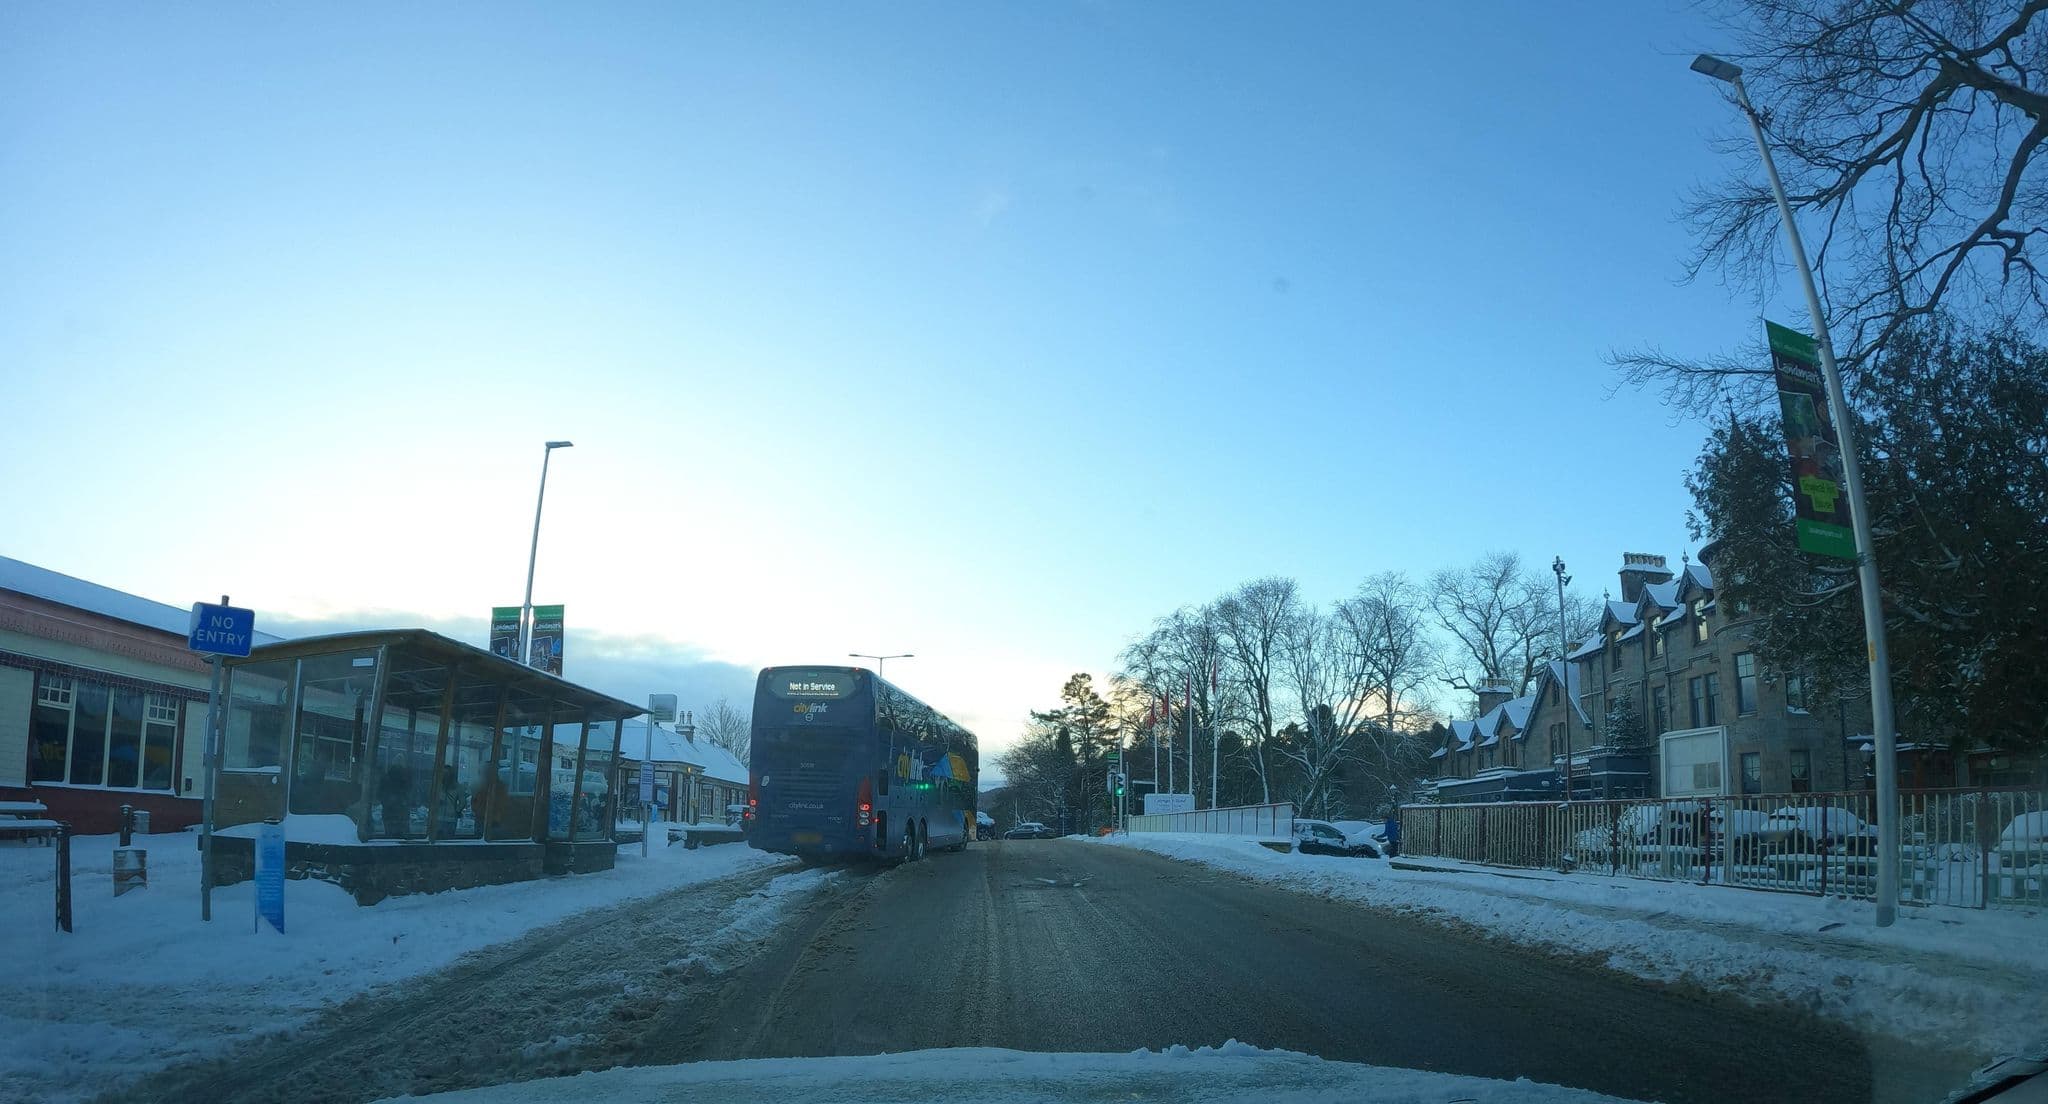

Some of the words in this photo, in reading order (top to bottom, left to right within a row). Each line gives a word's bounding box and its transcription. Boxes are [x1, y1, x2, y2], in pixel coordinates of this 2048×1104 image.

[211, 615, 234, 629] NO
[197, 629, 245, 645] ENTRY
[789, 682, 802, 690] Not
[803, 682, 809, 690] in
[810, 682, 836, 690] Service
[793, 702, 828, 714] citylink
[897, 746, 925, 784] citylink
